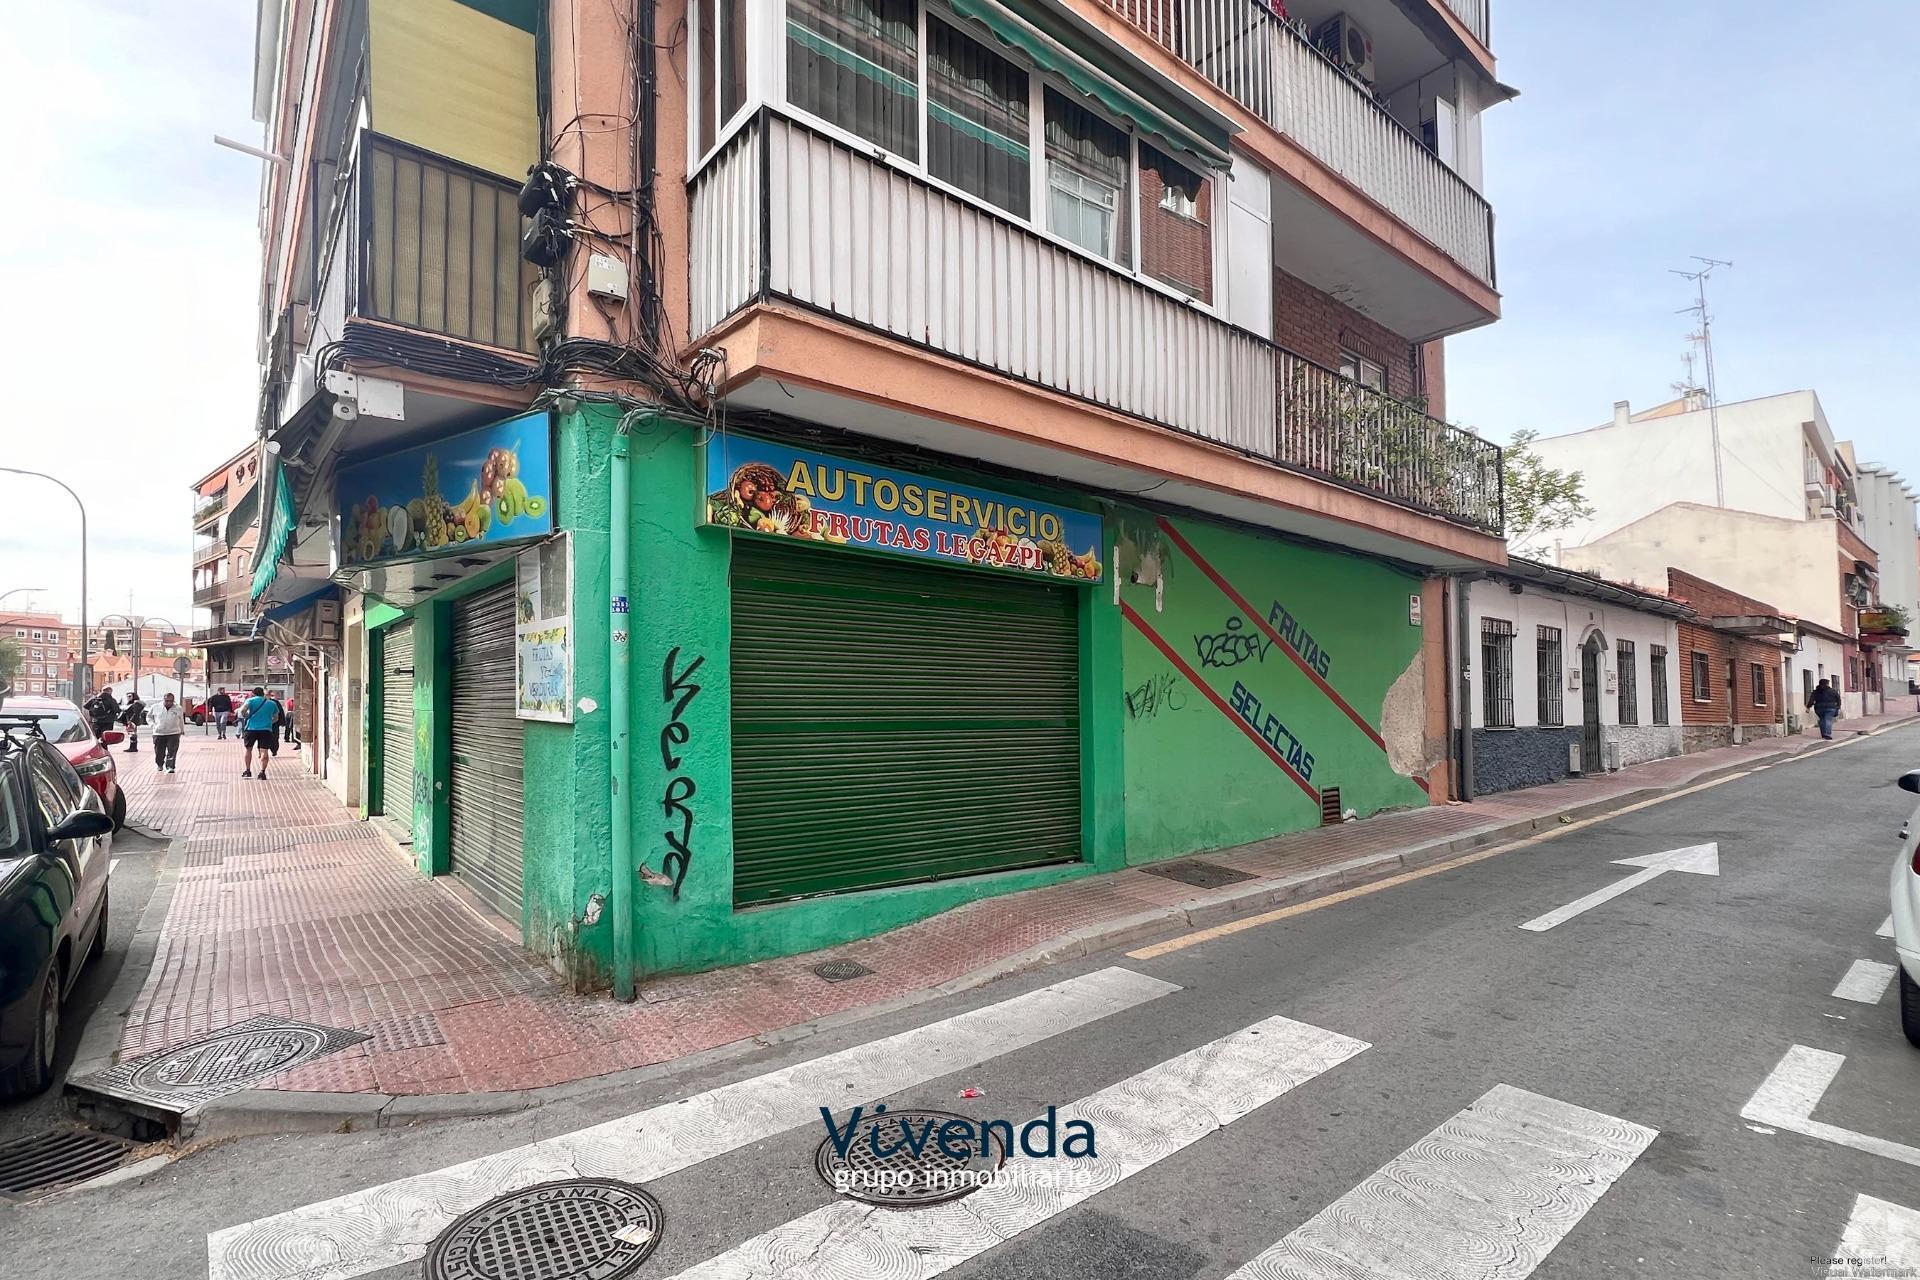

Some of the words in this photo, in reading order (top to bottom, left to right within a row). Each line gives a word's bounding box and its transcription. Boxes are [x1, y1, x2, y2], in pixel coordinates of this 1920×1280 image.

[785, 459, 1060, 541] AUTOSERVICIO
[808, 509, 931, 552] FRUTAS
[936, 531, 1043, 570] LEGAZPI
[1269, 600, 1331, 679] FRUTAS
[1229, 680, 1315, 781] SELECTAS
[536, 1188, 611, 1201] CANAL
[613, 1196, 641, 1214] DE
